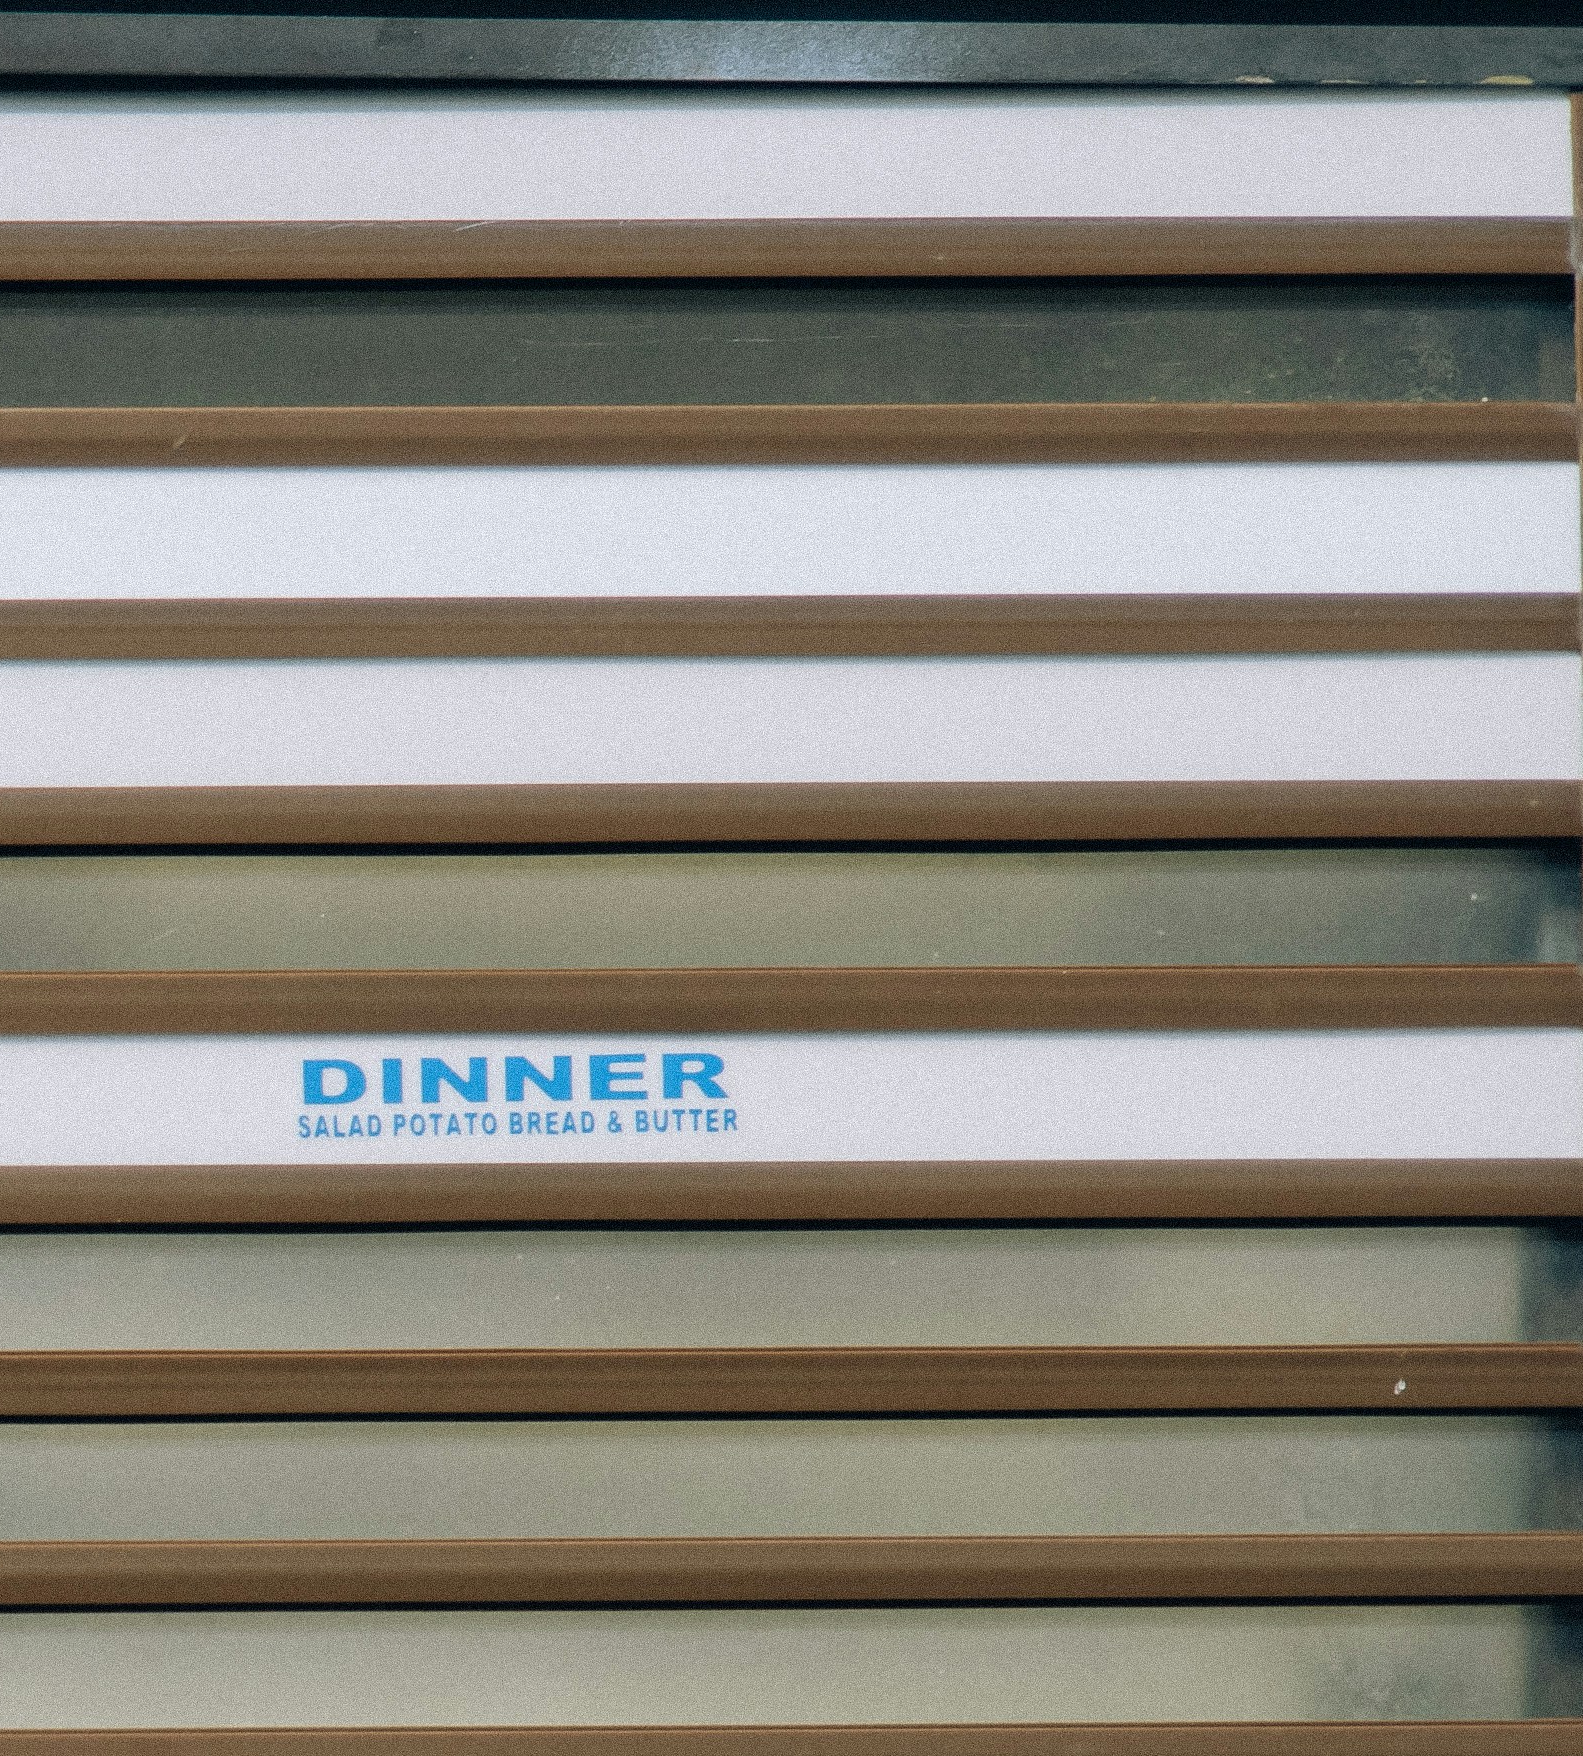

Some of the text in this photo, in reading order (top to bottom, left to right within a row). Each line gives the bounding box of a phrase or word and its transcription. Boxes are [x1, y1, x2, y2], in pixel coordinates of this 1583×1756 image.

[302, 1052, 729, 1105] DINNER
[298, 1108, 738, 1139] SALAD POTATO BREAD & BUTTER
